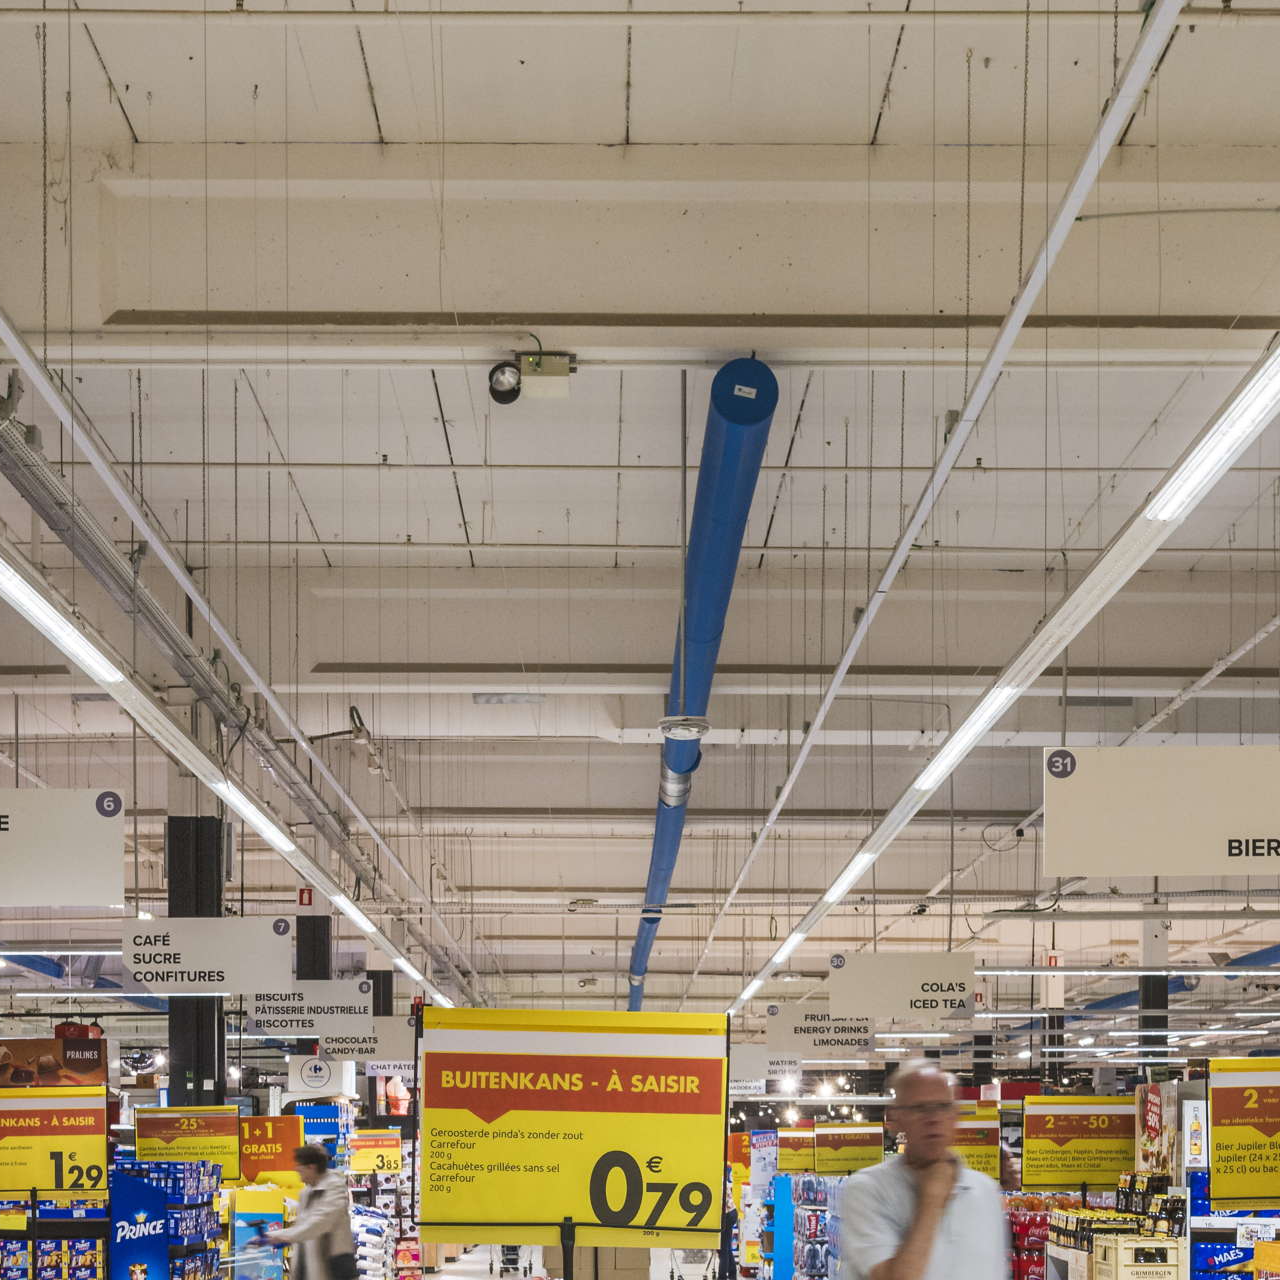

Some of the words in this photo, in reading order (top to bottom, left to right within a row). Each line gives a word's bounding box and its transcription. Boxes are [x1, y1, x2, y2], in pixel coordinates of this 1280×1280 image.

[1051, 757, 1072, 772] 31
[103, 797, 114, 811] 6
[278, 923, 285, 932] 7
[133, 931, 170, 946] CAFÉ
[133, 953, 181, 964] SUCRE
[831, 958, 845, 966] 30
[133, 971, 225, 982] CONFITURES
[921, 982, 966, 993] COLA'S
[255, 993, 304, 1001] BISCUITS
[255, 1004, 304, 1015] PÂTISSERIE
[307, 1006, 368, 1015] INDUSTRIELLE
[910, 999, 938, 1009] ICED
[942, 999, 966, 1009] TEA
[255, 1019, 314, 1028] BISCOTTES
[794, 1026, 832, 1034] ENERGY
[834, 1026, 869, 1034] DRINKS
[325, 1036, 378, 1044] CHOCOLATS
[813, 1039, 869, 1047] LIMONADES
[66, 1051, 98, 1059] PRALINES
[325, 1047, 376, 1055] CANDY-BAR
[441, 1070, 584, 1092] BUITENKANS
[606, 1069, 623, 1092] À
[631, 1075, 700, 1094] SAISIR
[1243, 1088, 1259, 1109] 2
[51, 1115, 59, 1126] À
[63, 1116, 96, 1126] SAISIR
[430, 1128, 490, 1139] Geroosterde
[492, 1129, 525, 1142] pinda's
[527, 1129, 561, 1140] zonder
[563, 1131, 584, 1140] zout
[242, 1143, 282, 1154] GRATIS
[430, 1139, 476, 1150] Carrefour
[1215, 1142, 1234, 1151] Bier
[1236, 1141, 1267, 1152] Jupiler
[430, 1151, 445, 1159] 200
[1216, 1153, 1247, 1164] Jupiler
[1249, 1153, 1263, 1163] (24
[430, 1160, 484, 1172] Cacahuètes
[487, 1161, 521, 1174] grillées
[523, 1165, 544, 1173] sans
[546, 1163, 561, 1173] sel
[1223, 1165, 1234, 1174] 25
[1263, 1165, 1279, 1173] bac
[429, 1173, 475, 1184] Carrefour
[429, 1184, 444, 1192] 200
[1214, 1249, 1244, 1265] MAES
[1130, 1269, 1172, 1278] GRIMBERGEN
